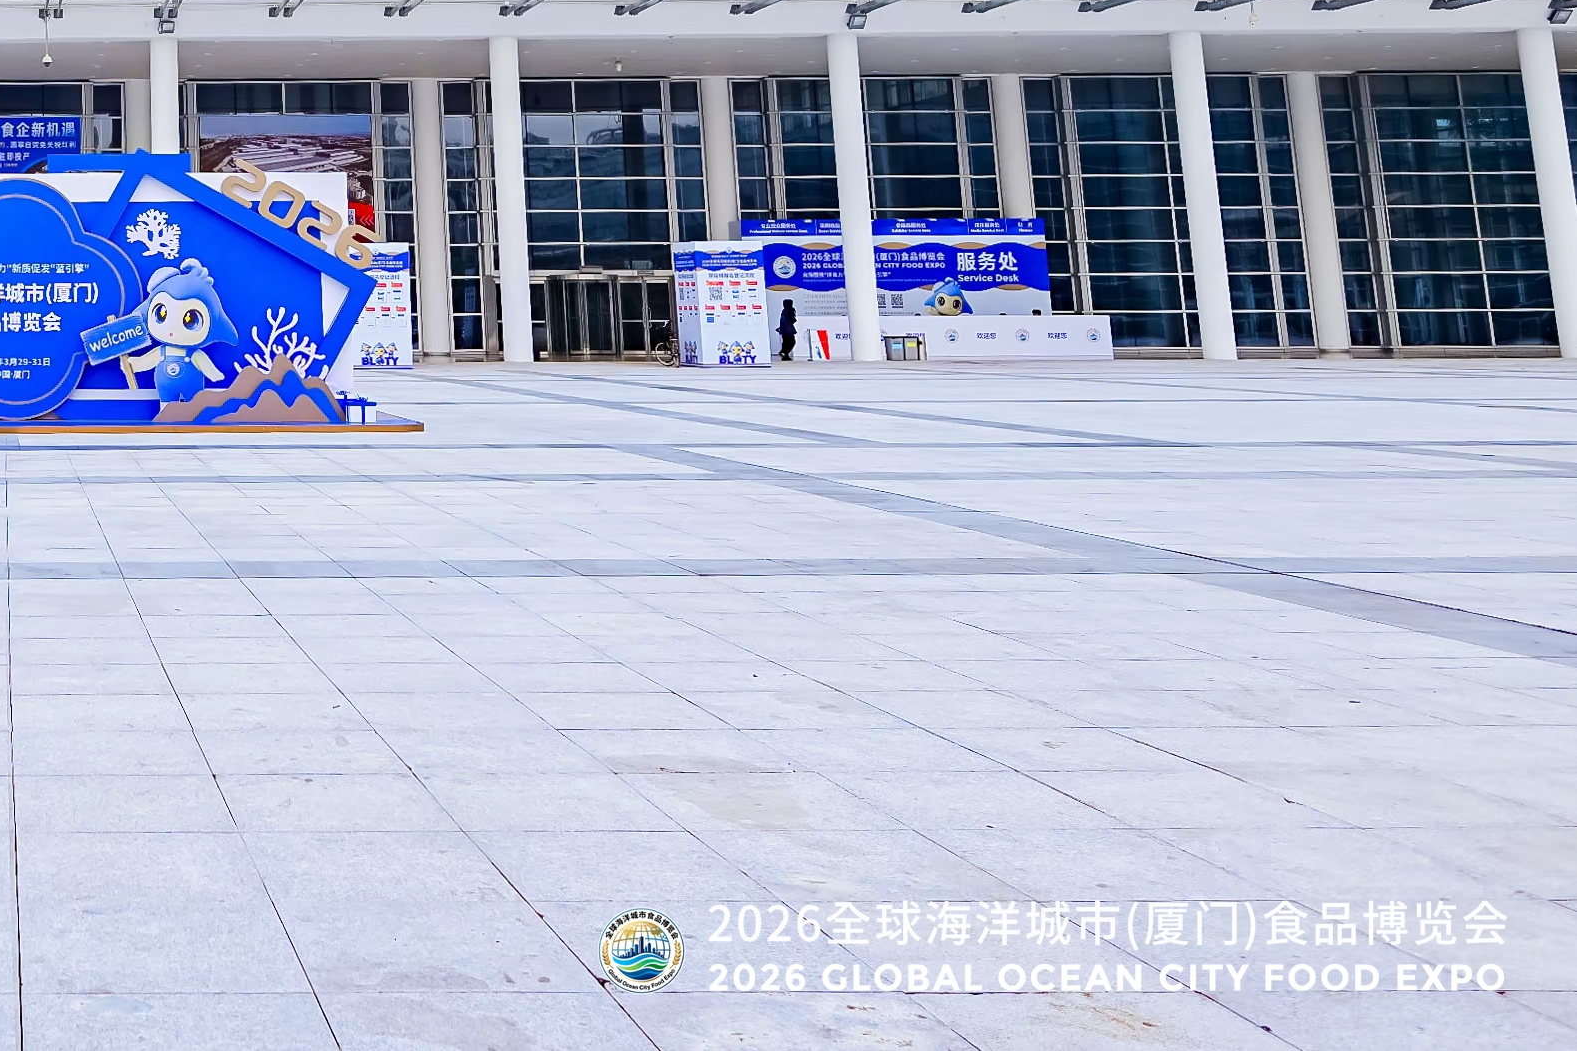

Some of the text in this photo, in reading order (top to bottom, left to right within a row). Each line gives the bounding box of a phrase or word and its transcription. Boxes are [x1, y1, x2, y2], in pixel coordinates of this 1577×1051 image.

[1, 122, 76, 138] 食企新机遇
[221, 158, 384, 269] 2026
[957, 251, 1018, 272] 服务处
[958, 274, 1019, 283] Service Desk
[89, 325, 143, 352] welcome
[361, 357, 399, 366] BLTY
[719, 355, 758, 365] BLTY
